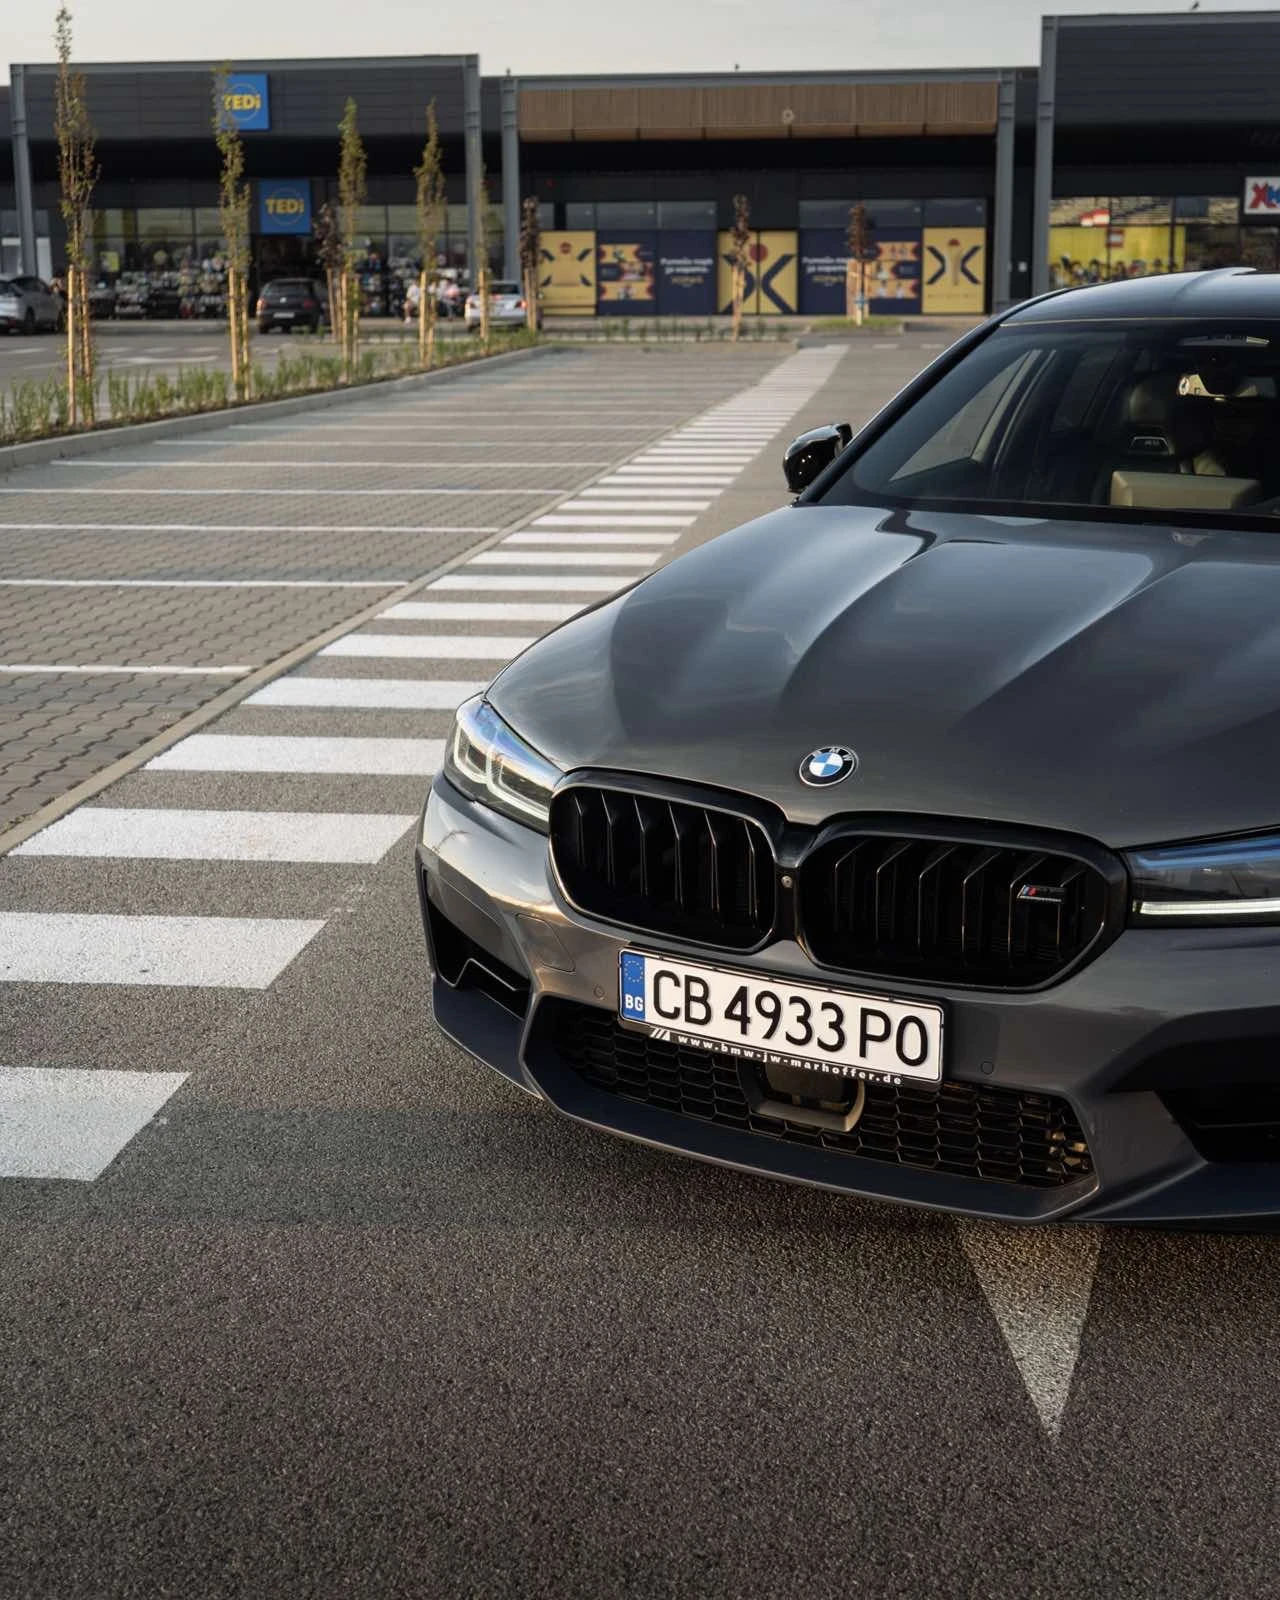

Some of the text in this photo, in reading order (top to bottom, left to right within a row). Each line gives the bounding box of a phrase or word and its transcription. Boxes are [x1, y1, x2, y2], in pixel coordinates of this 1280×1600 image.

[266, 199, 304, 214] TEDi
[811, 747, 852, 761] BMW
[625, 994, 644, 1011] BG
[653, 969, 712, 1026] CB
[724, 985, 846, 1052] 4933
[677, 1034, 902, 1085] www.bmw-jw-marhoffer.de
